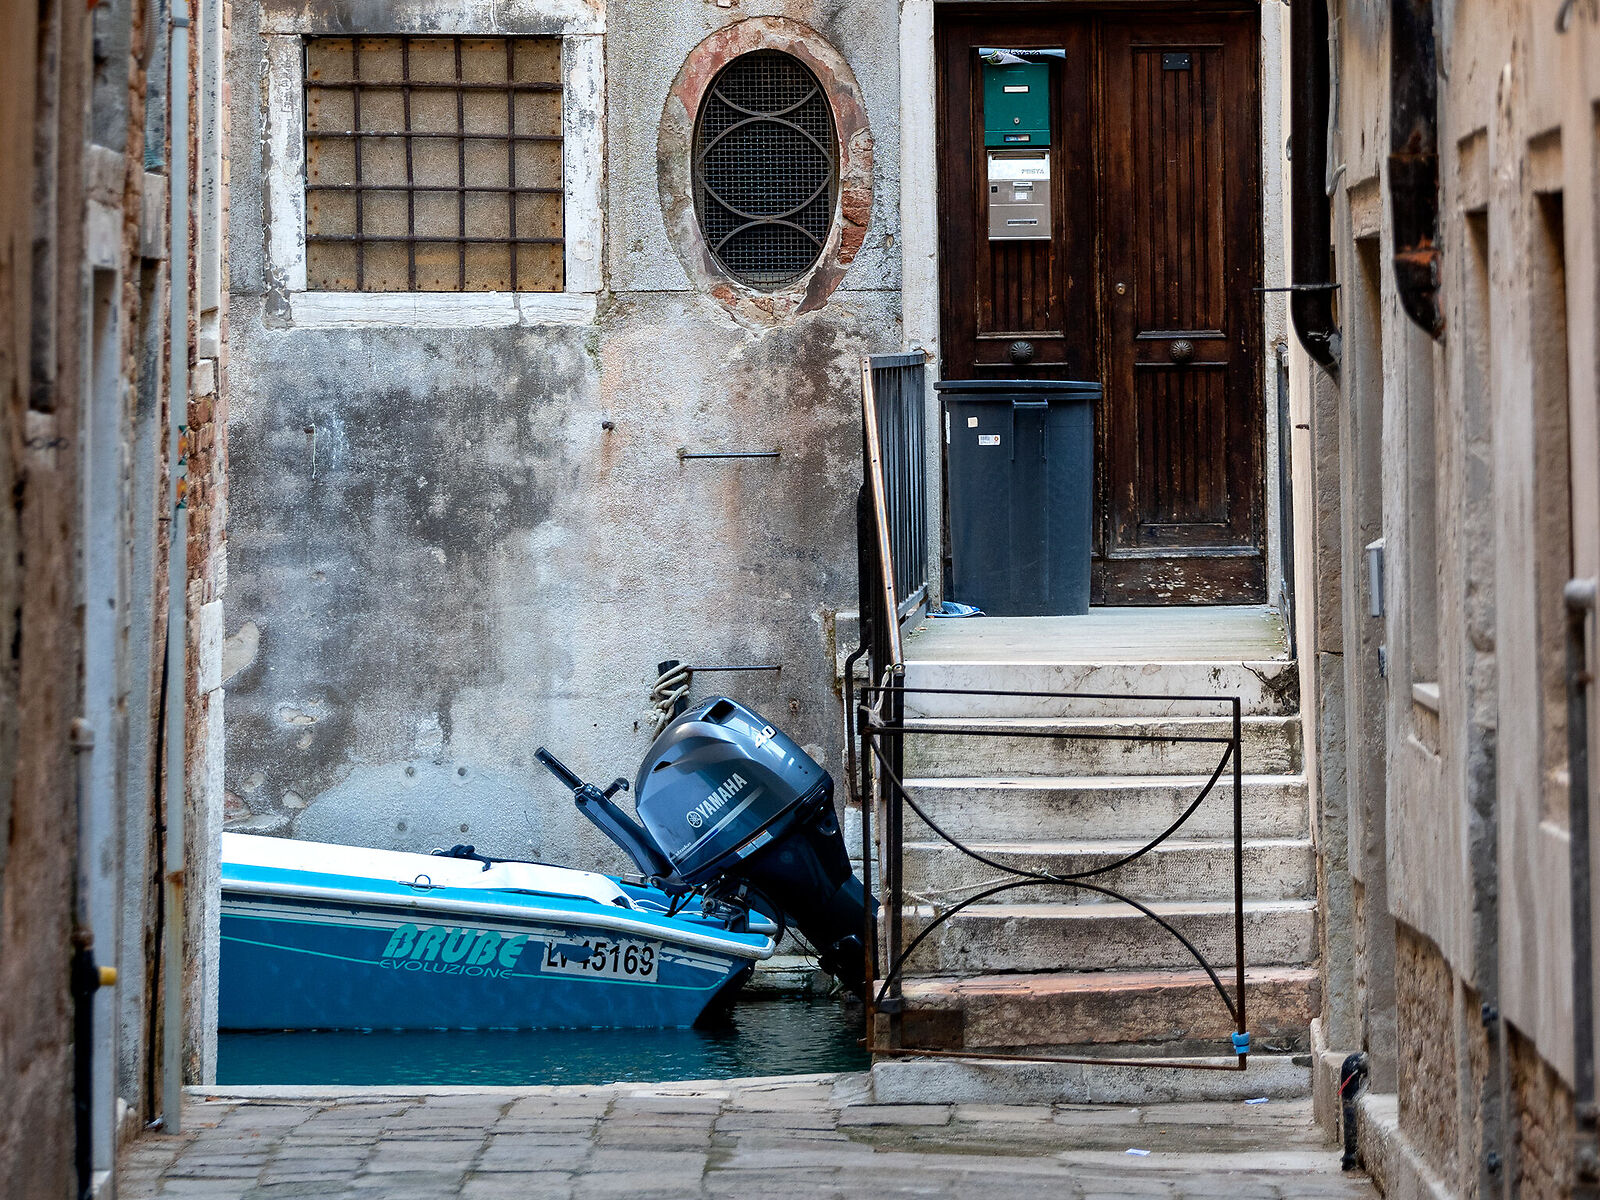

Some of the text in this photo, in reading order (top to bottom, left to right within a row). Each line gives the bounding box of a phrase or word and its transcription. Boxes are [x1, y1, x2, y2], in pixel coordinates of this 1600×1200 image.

[755, 724, 778, 749] 40
[696, 772, 748, 819] YAMAHA
[382, 923, 530, 968] BRUBE
[379, 958, 513, 979] EVOLUZIONE
